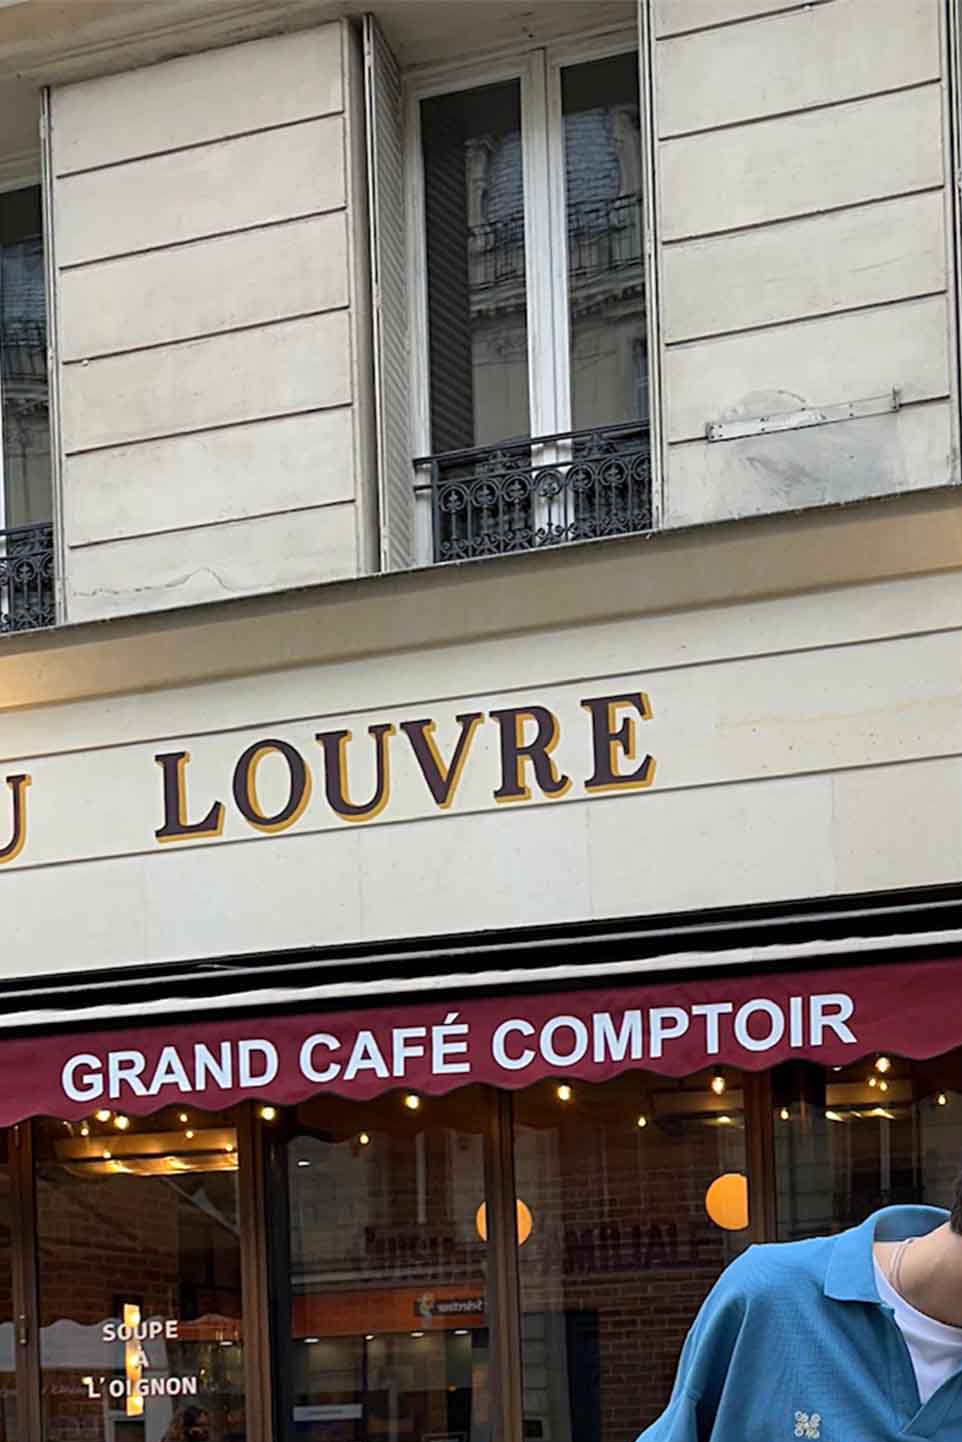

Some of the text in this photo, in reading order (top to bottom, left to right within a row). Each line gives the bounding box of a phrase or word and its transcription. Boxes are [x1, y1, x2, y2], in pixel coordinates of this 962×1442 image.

[154, 692, 655, 843] LOUVRE
[61, 993, 857, 1102] GRAND CAFÉ COMPTOIR
[102, 1320, 178, 1342] SOUPE
[87, 1376, 197, 1398] L'OIGNON
